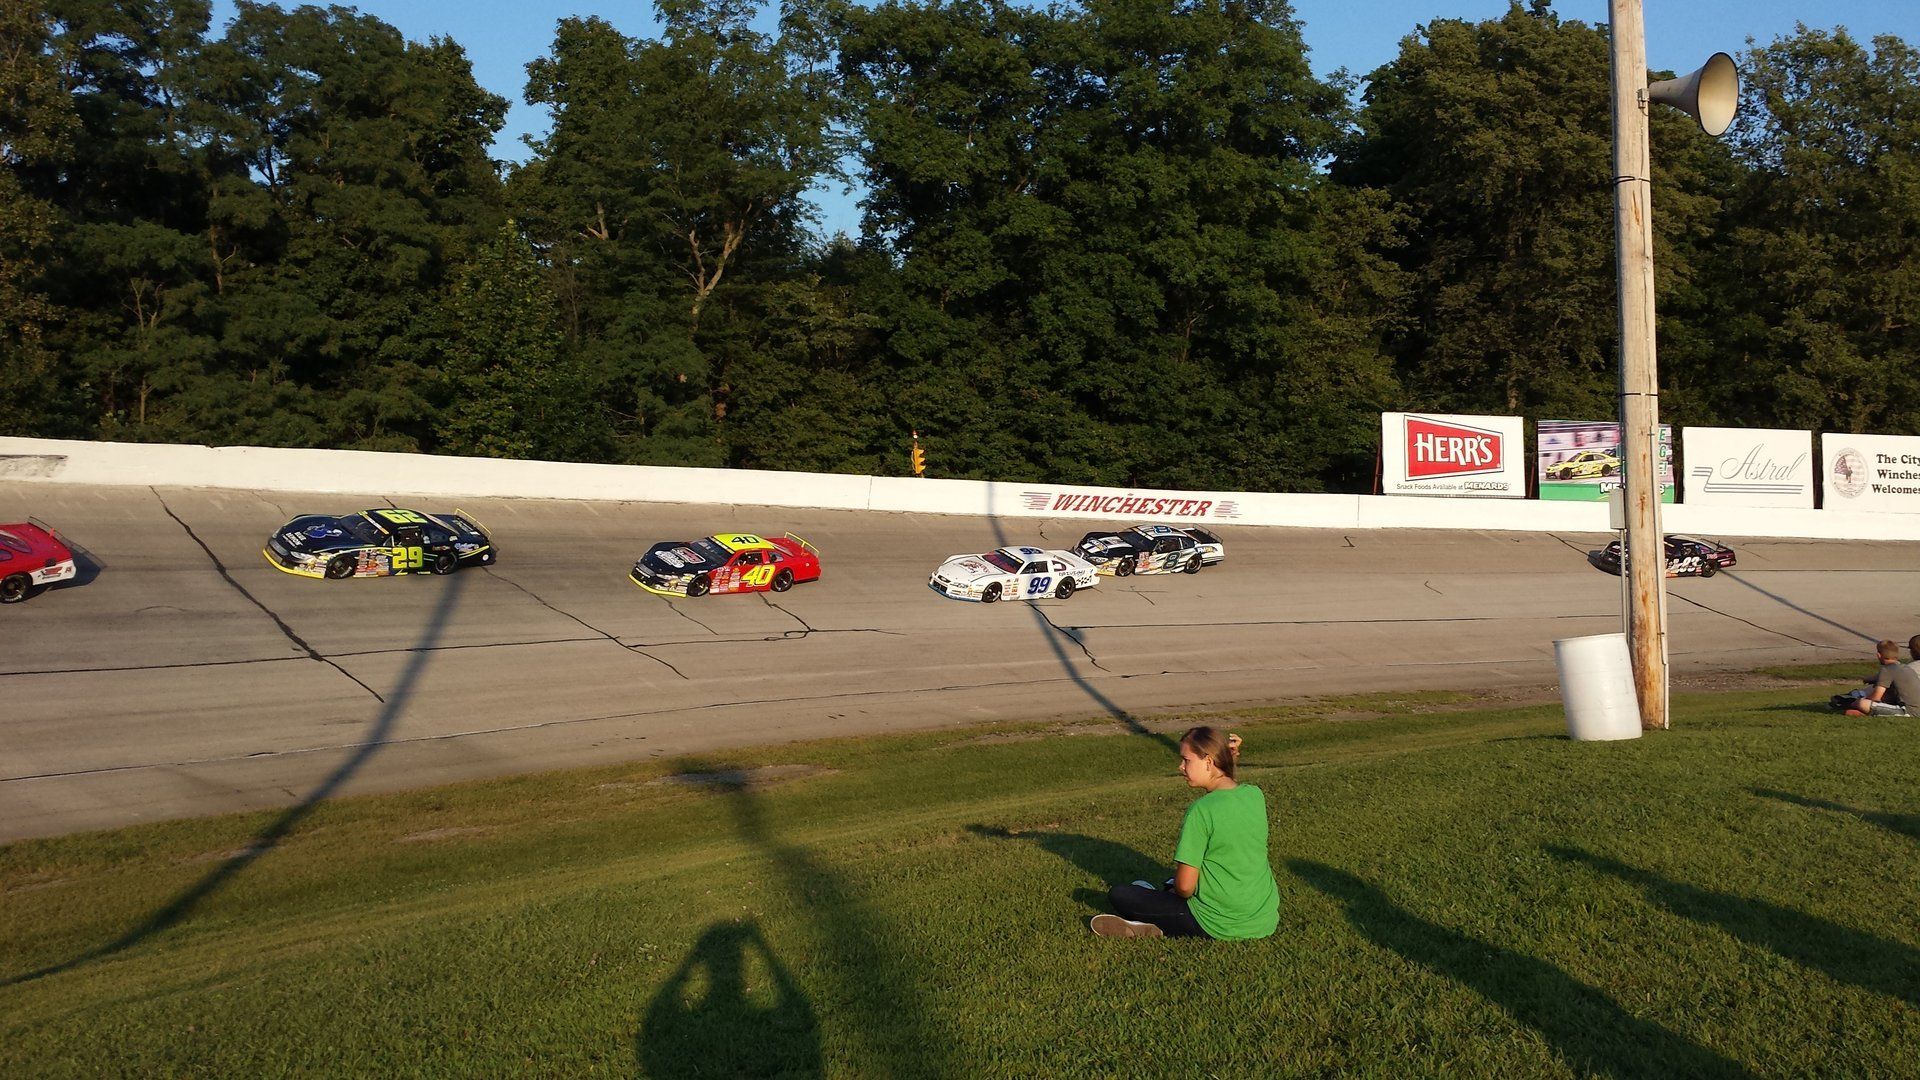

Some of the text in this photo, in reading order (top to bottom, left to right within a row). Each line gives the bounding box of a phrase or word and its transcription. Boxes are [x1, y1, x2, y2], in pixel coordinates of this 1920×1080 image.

[1413, 432, 1493, 466] HERR'S
[1876, 453, 1897, 464] The
[1720, 443, 1807, 480] Astral
[1463, 482, 1509, 491] MENARDS
[1052, 493, 1213, 517] WINCHESTER
[731, 536, 760, 544] 40
[392, 546, 423, 569] 29
[1161, 550, 1181, 571] 8
[740, 564, 776, 587] 40
[1026, 576, 1052, 595] 99
